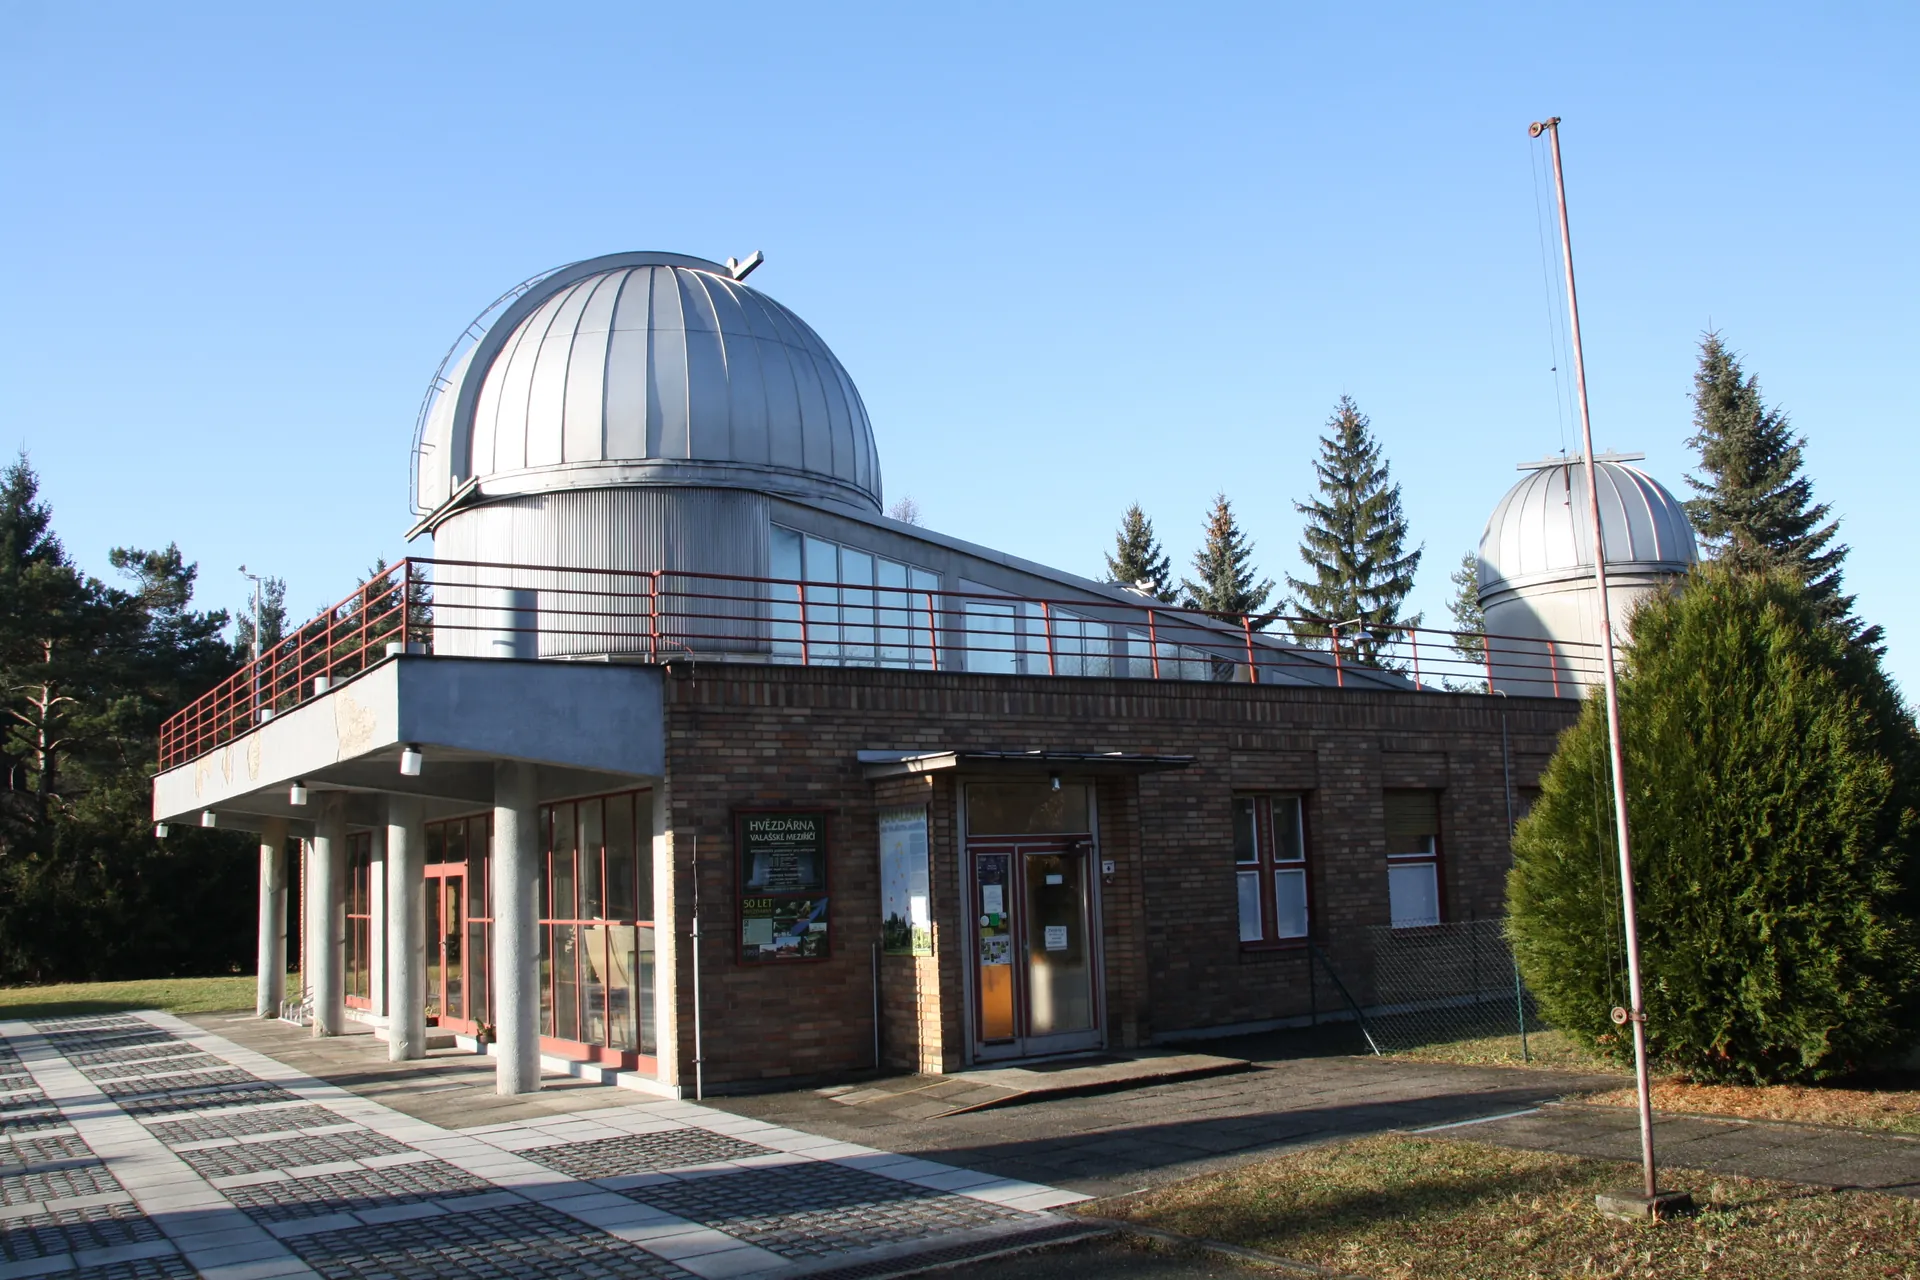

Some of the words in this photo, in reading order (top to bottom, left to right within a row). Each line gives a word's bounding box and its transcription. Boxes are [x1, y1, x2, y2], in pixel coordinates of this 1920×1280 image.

[750, 818, 815, 831] HVĚZDÁRNA
[750, 832, 785, 841] VALAŠSKÉ
[786, 831, 816, 841] MEZIŘÍČÍ
[743, 899, 755, 909] 50
[757, 898, 773, 908] LET
